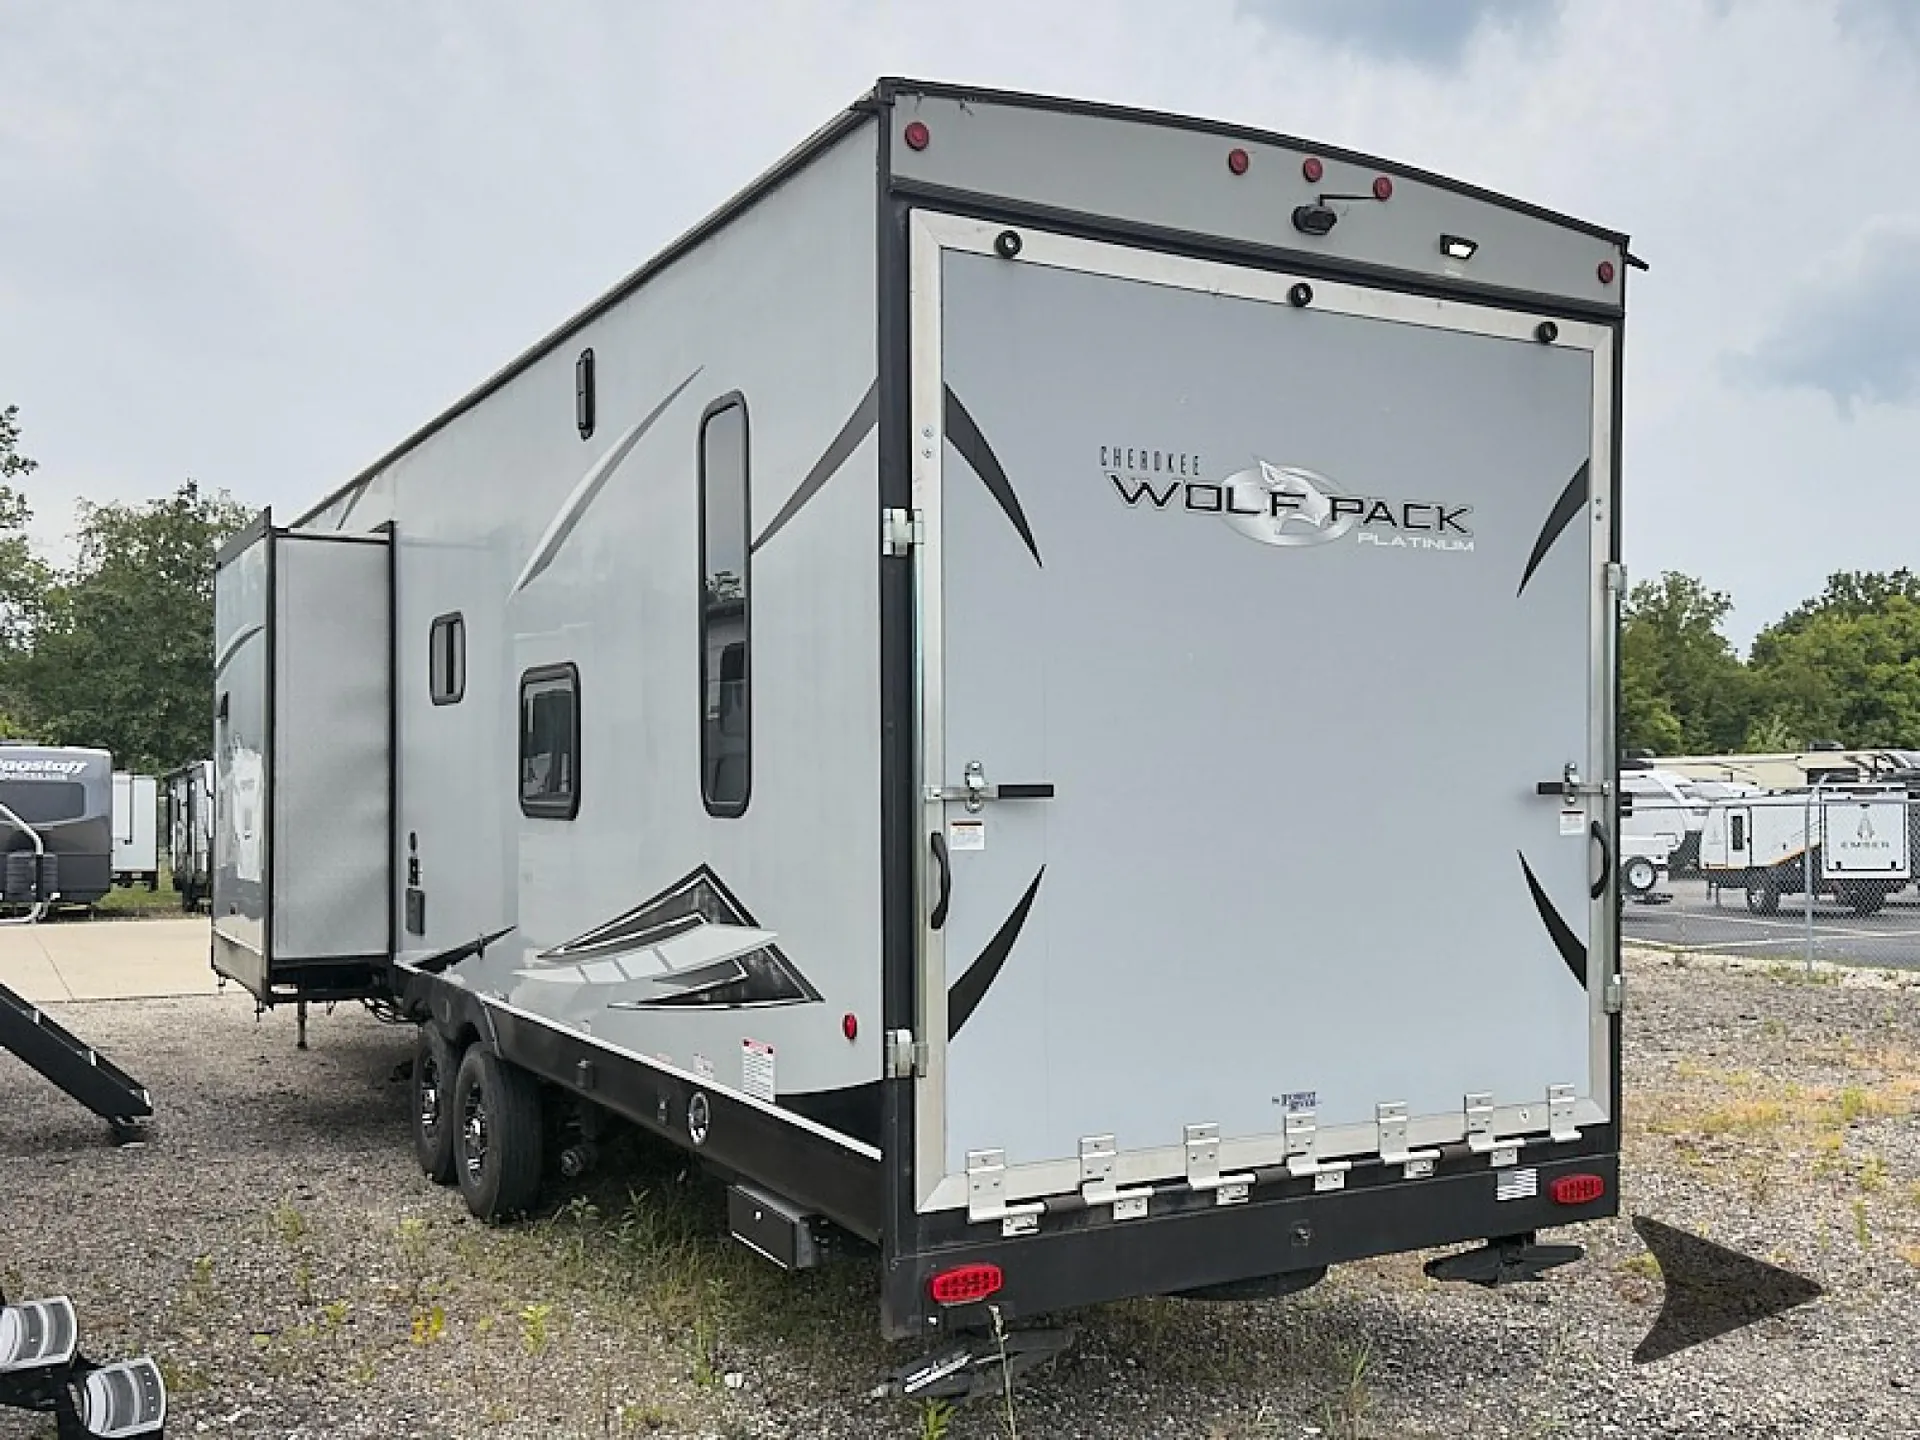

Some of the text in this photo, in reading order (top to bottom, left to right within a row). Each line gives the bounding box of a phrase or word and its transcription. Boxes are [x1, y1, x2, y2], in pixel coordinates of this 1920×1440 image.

[1100, 445, 1200, 476] CHEROKEE
[1105, 471, 1472, 536] WOLF PACK
[1357, 532, 1475, 552] PLATINUM
